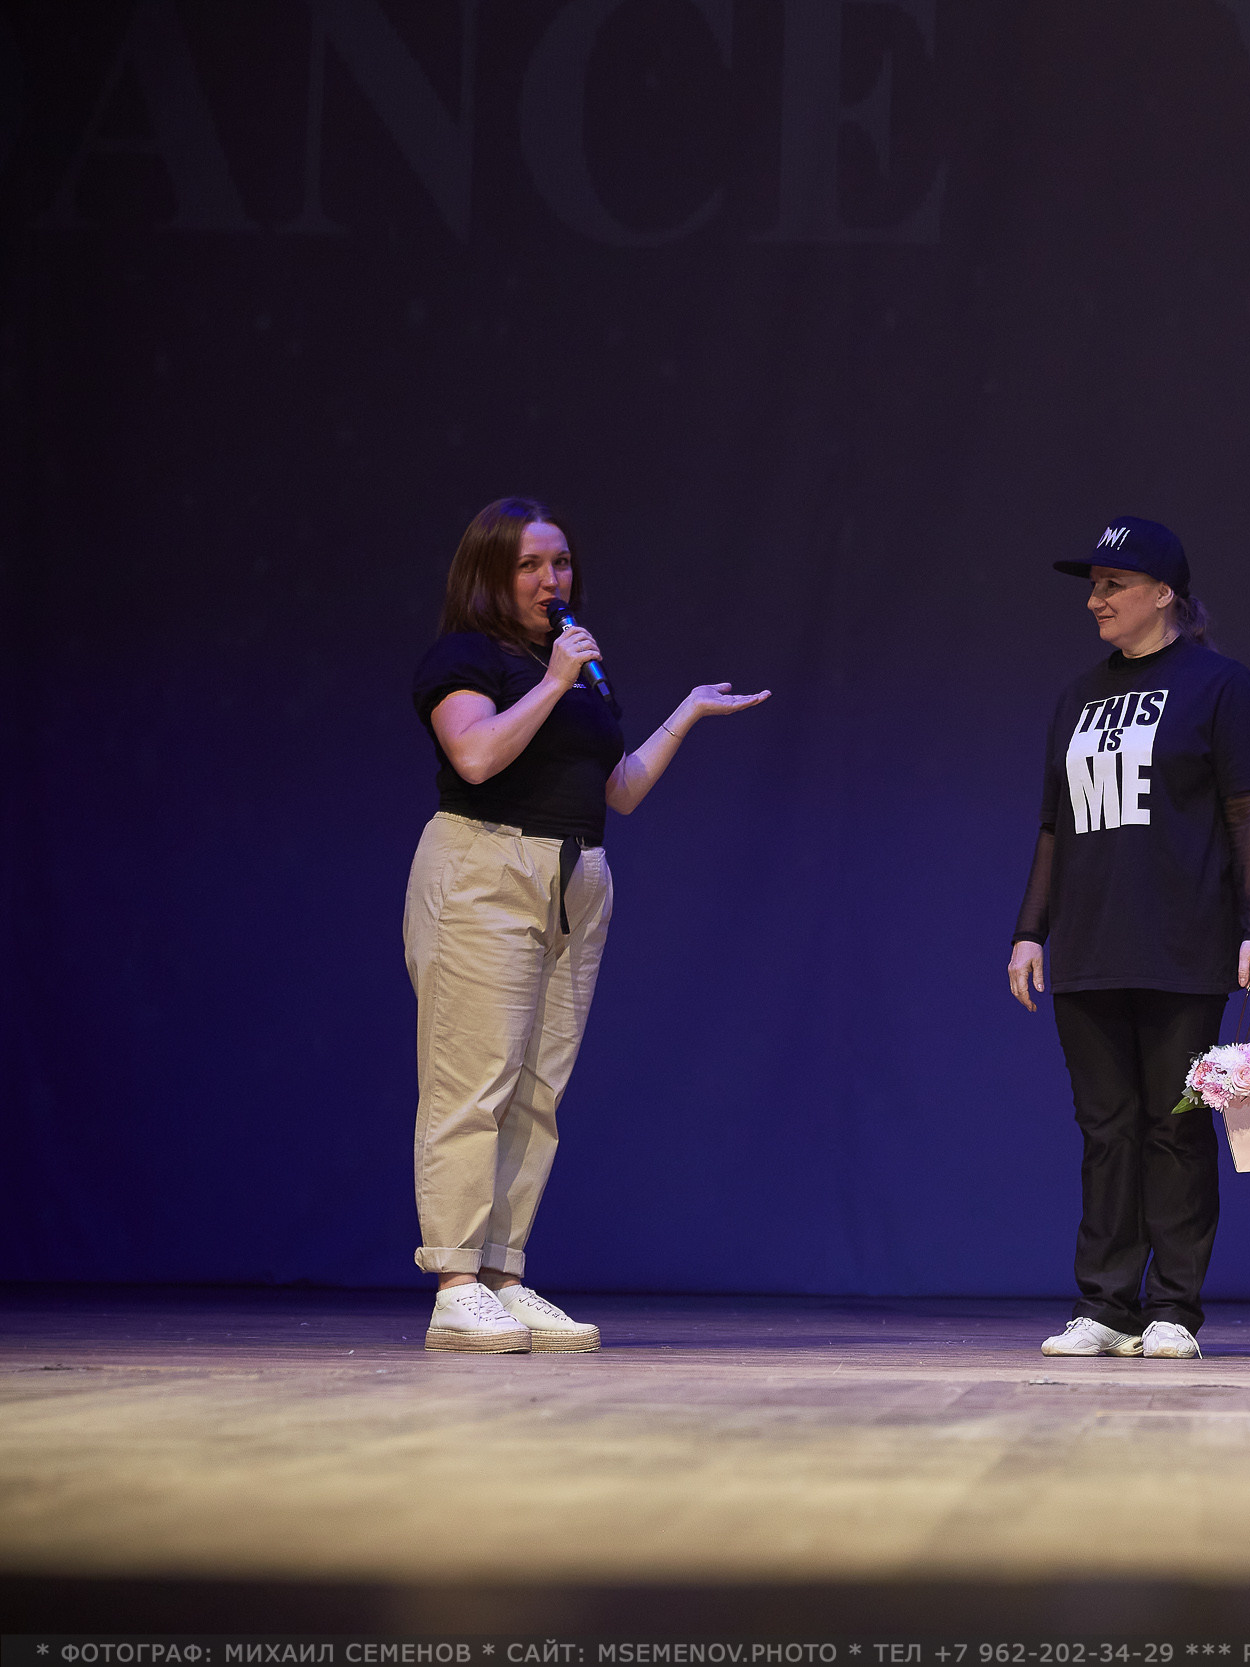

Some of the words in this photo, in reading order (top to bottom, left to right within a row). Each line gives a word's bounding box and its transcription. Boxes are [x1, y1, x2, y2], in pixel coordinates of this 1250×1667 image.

[0, 0, 950, 246] ANCE
[1078, 690, 1166, 734] THIS
[1097, 728, 1124, 753] IS
[1065, 751, 1153, 835] ME
